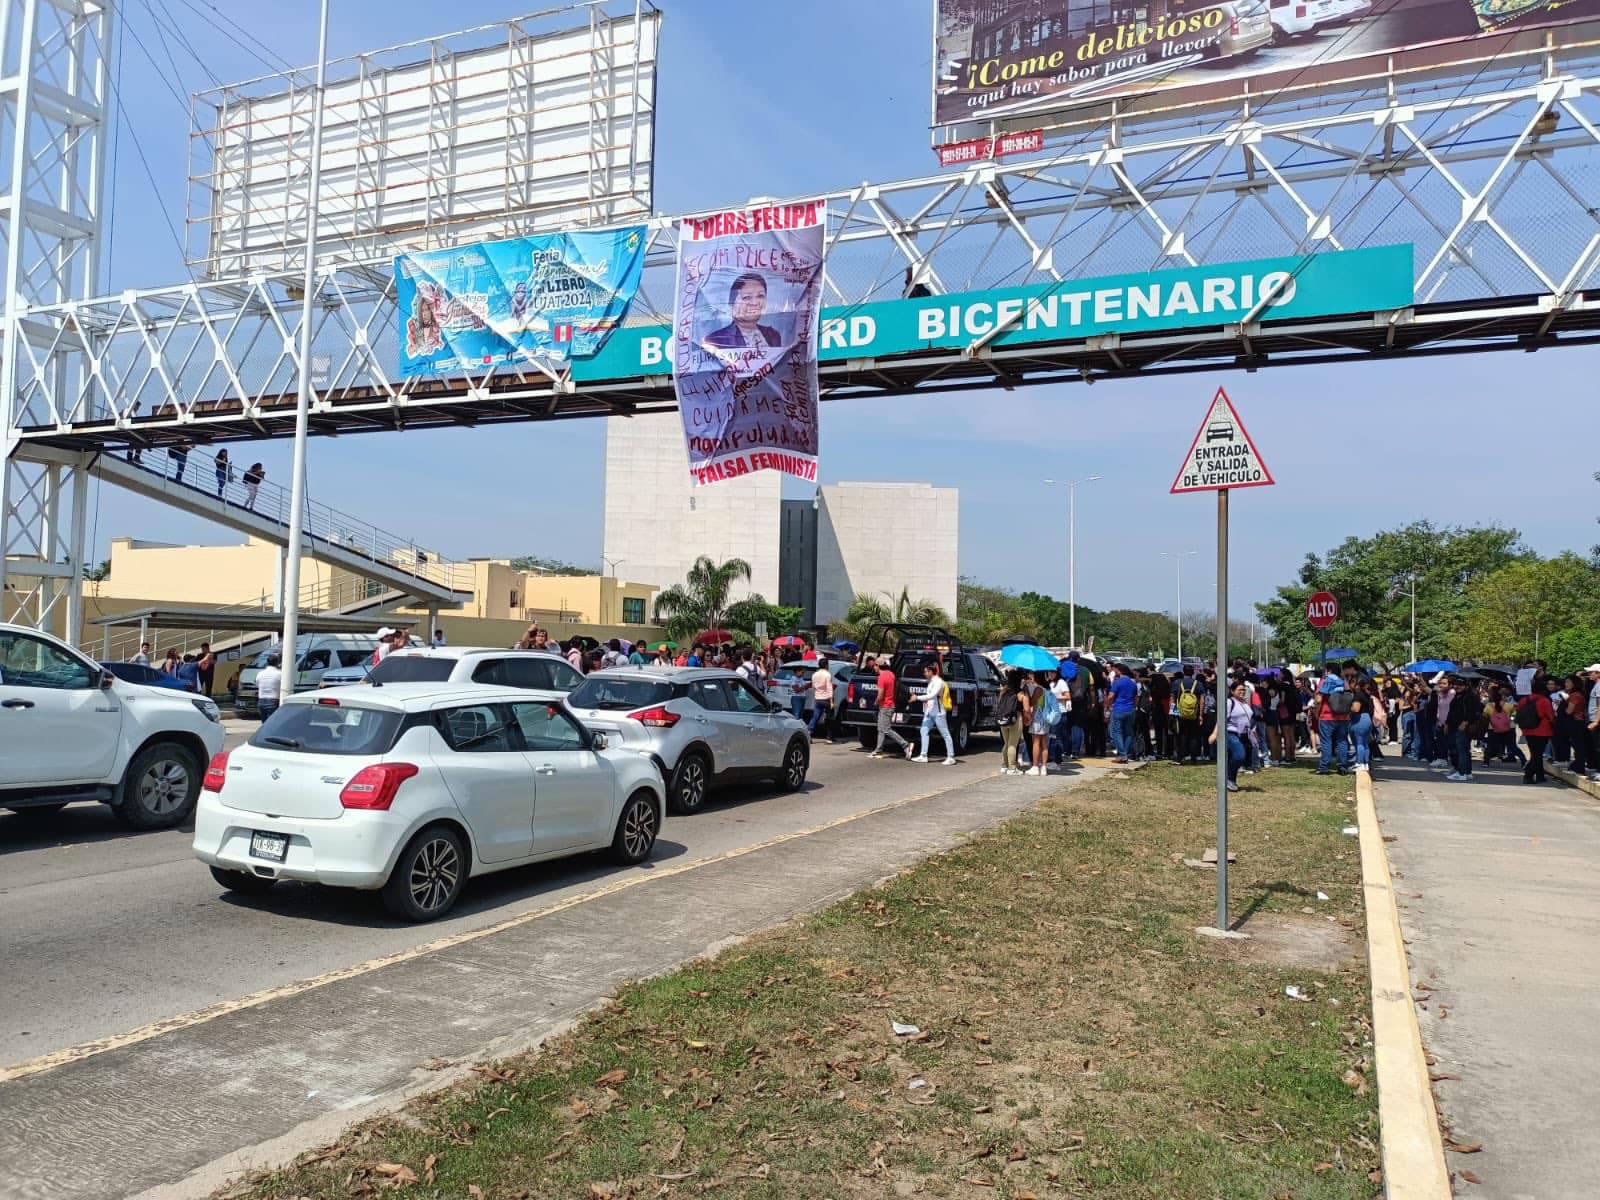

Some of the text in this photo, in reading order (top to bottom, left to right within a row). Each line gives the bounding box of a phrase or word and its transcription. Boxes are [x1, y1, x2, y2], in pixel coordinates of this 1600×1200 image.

[967, 9, 1224, 90] ¡Come delicioso
[967, 30, 1223, 107] aquí hay sabor para llevar!
[752, 199, 825, 233] FELIPA"
[533, 248, 561, 265] Feria
[546, 277, 586, 293] LIBRO
[564, 291, 592, 308] 2024
[917, 271, 1297, 341] BICENTENARIO
[1195, 444, 1249, 460] ENTRADA
[751, 451, 817, 481] FEMINISTA
[1196, 457, 1249, 473] Y SALIDA
[1183, 469, 1261, 487] DE VEHICULO
[1308, 601, 1336, 618] ALTO
